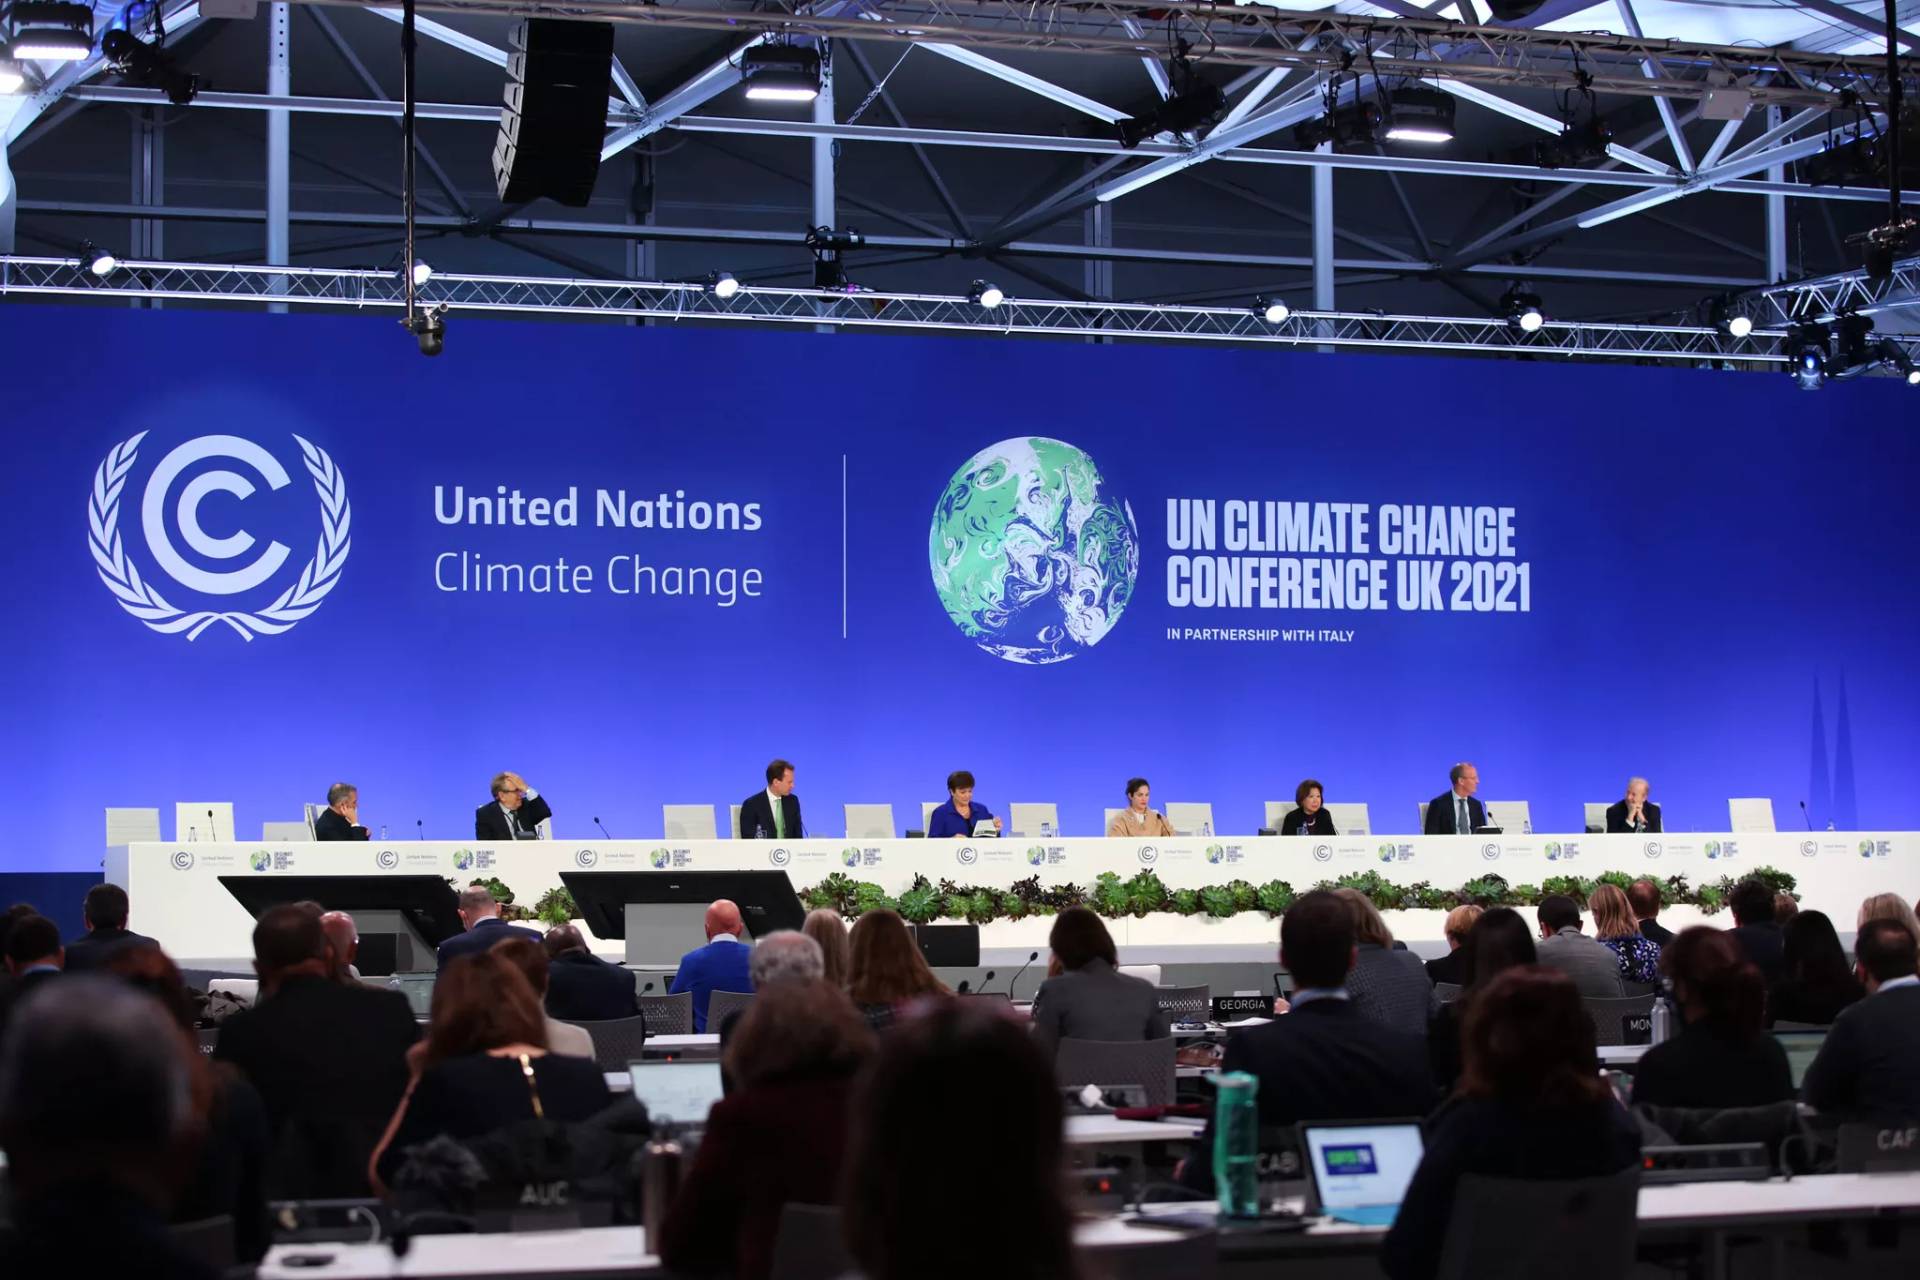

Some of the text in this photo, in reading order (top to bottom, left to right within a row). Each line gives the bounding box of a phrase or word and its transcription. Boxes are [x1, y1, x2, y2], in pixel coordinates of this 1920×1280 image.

[435, 485, 762, 531] United Nations
[1167, 499, 1516, 557] UN CLIMATE CHANGE
[435, 550, 763, 607] Climate Change
[1167, 555, 1530, 612] CONFERENCE UK 2021
[1167, 628, 1355, 642] IN PARTNERSHIP WITH ITALY
[1219, 998, 1266, 1011] GEORGIA
[520, 1180, 570, 1207] AUC
